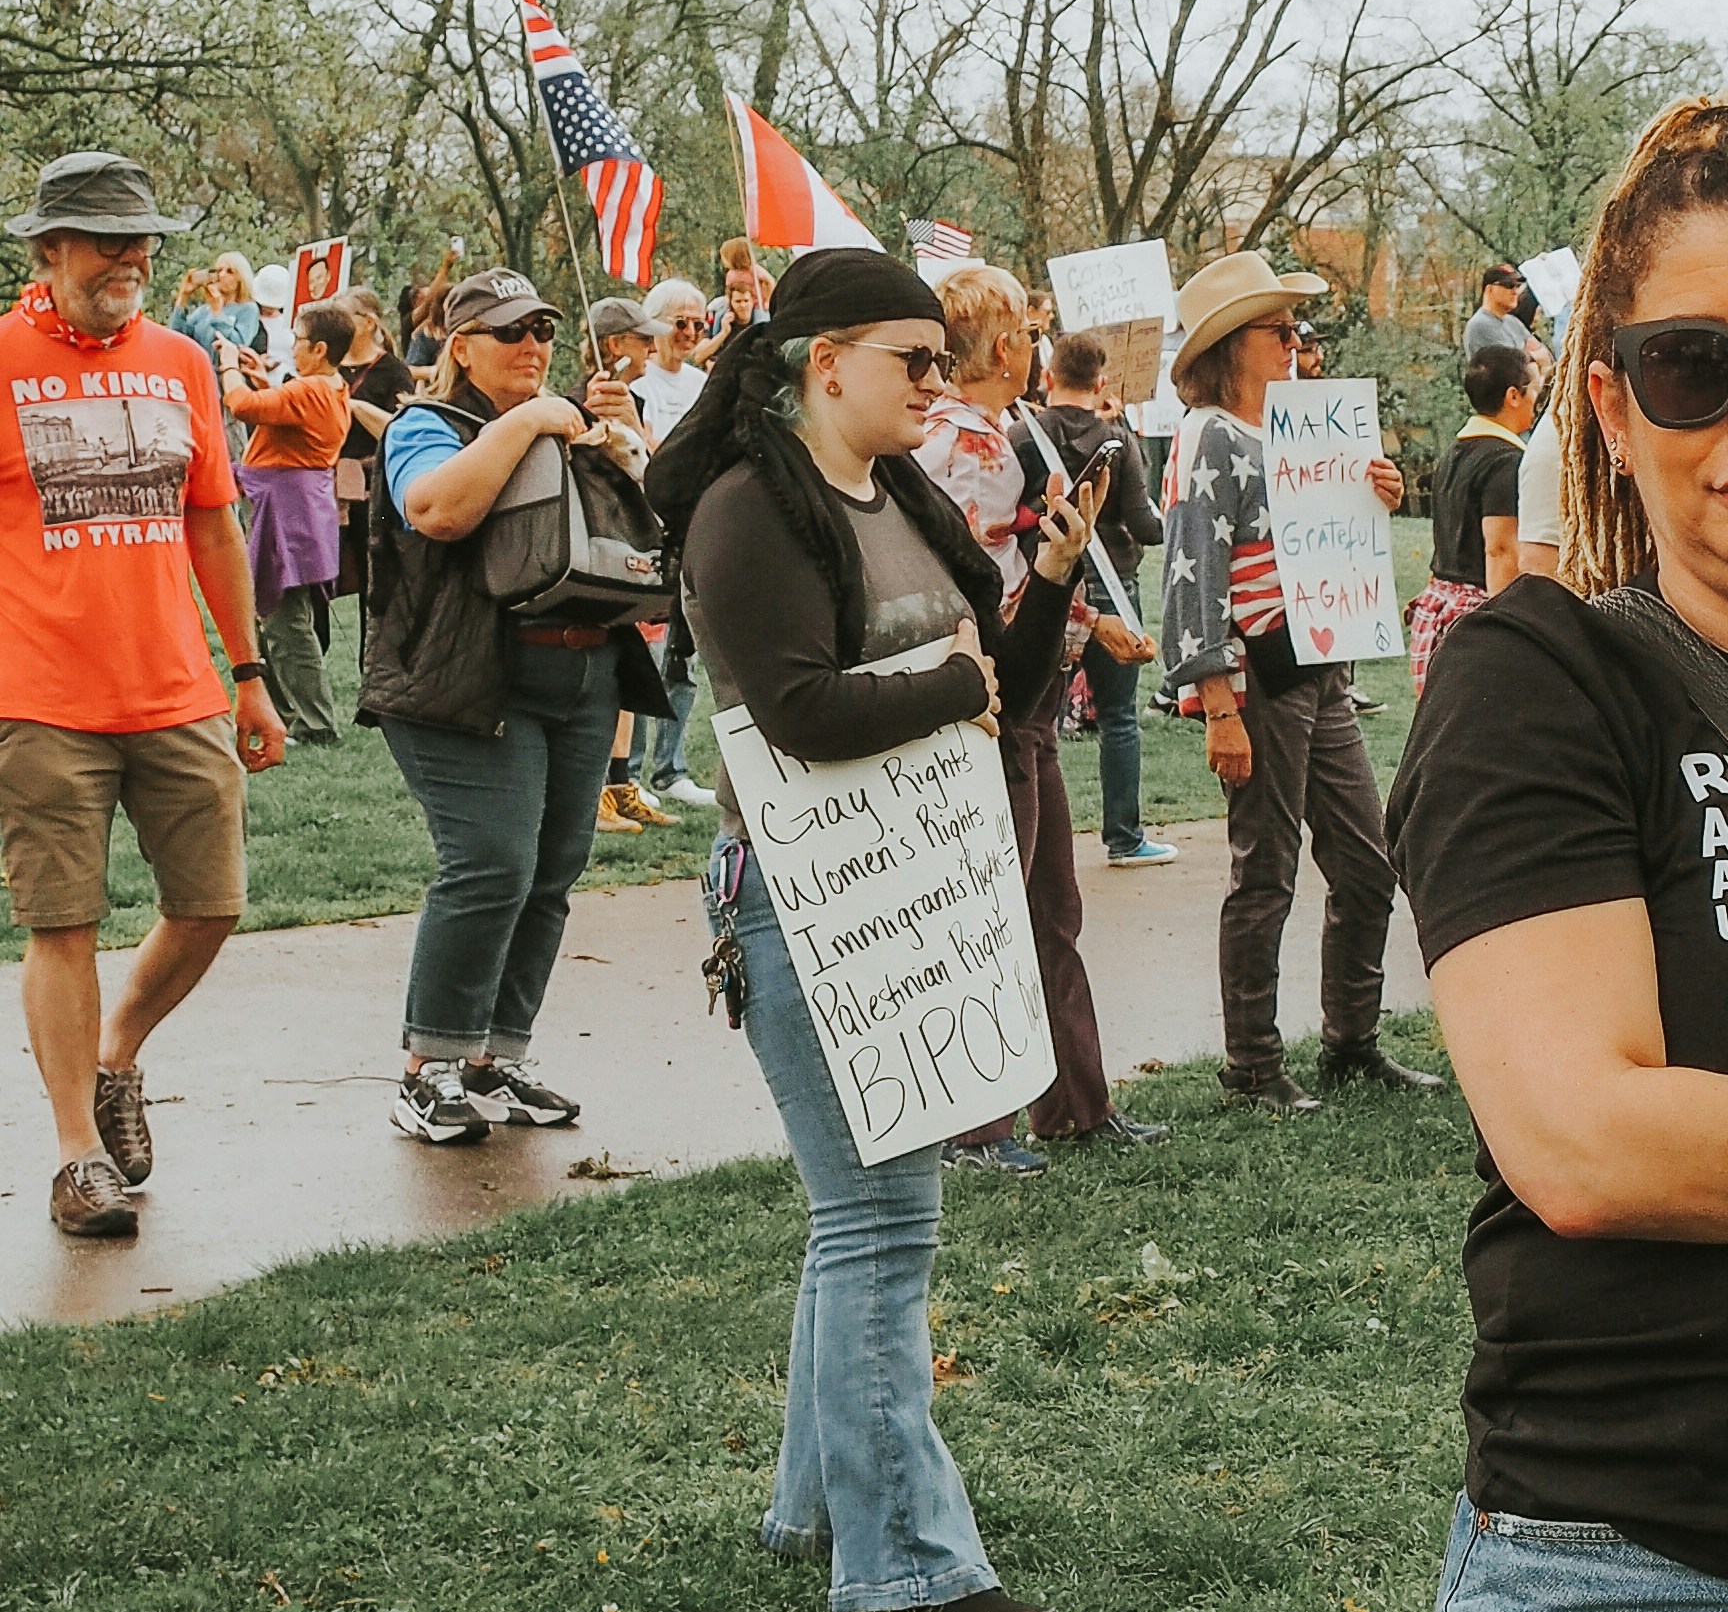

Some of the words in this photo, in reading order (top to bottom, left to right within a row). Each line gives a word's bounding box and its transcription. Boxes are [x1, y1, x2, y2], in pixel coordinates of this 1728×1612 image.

[11, 376, 67, 404] NO
[80, 372, 187, 402] KINGS
[1271, 397, 1370, 447] MAKE
[43, 528, 81, 552] NO
[761, 787, 885, 844] Gay
[882, 748, 974, 809] Rights
[812, 960, 953, 1049] Palestinian
